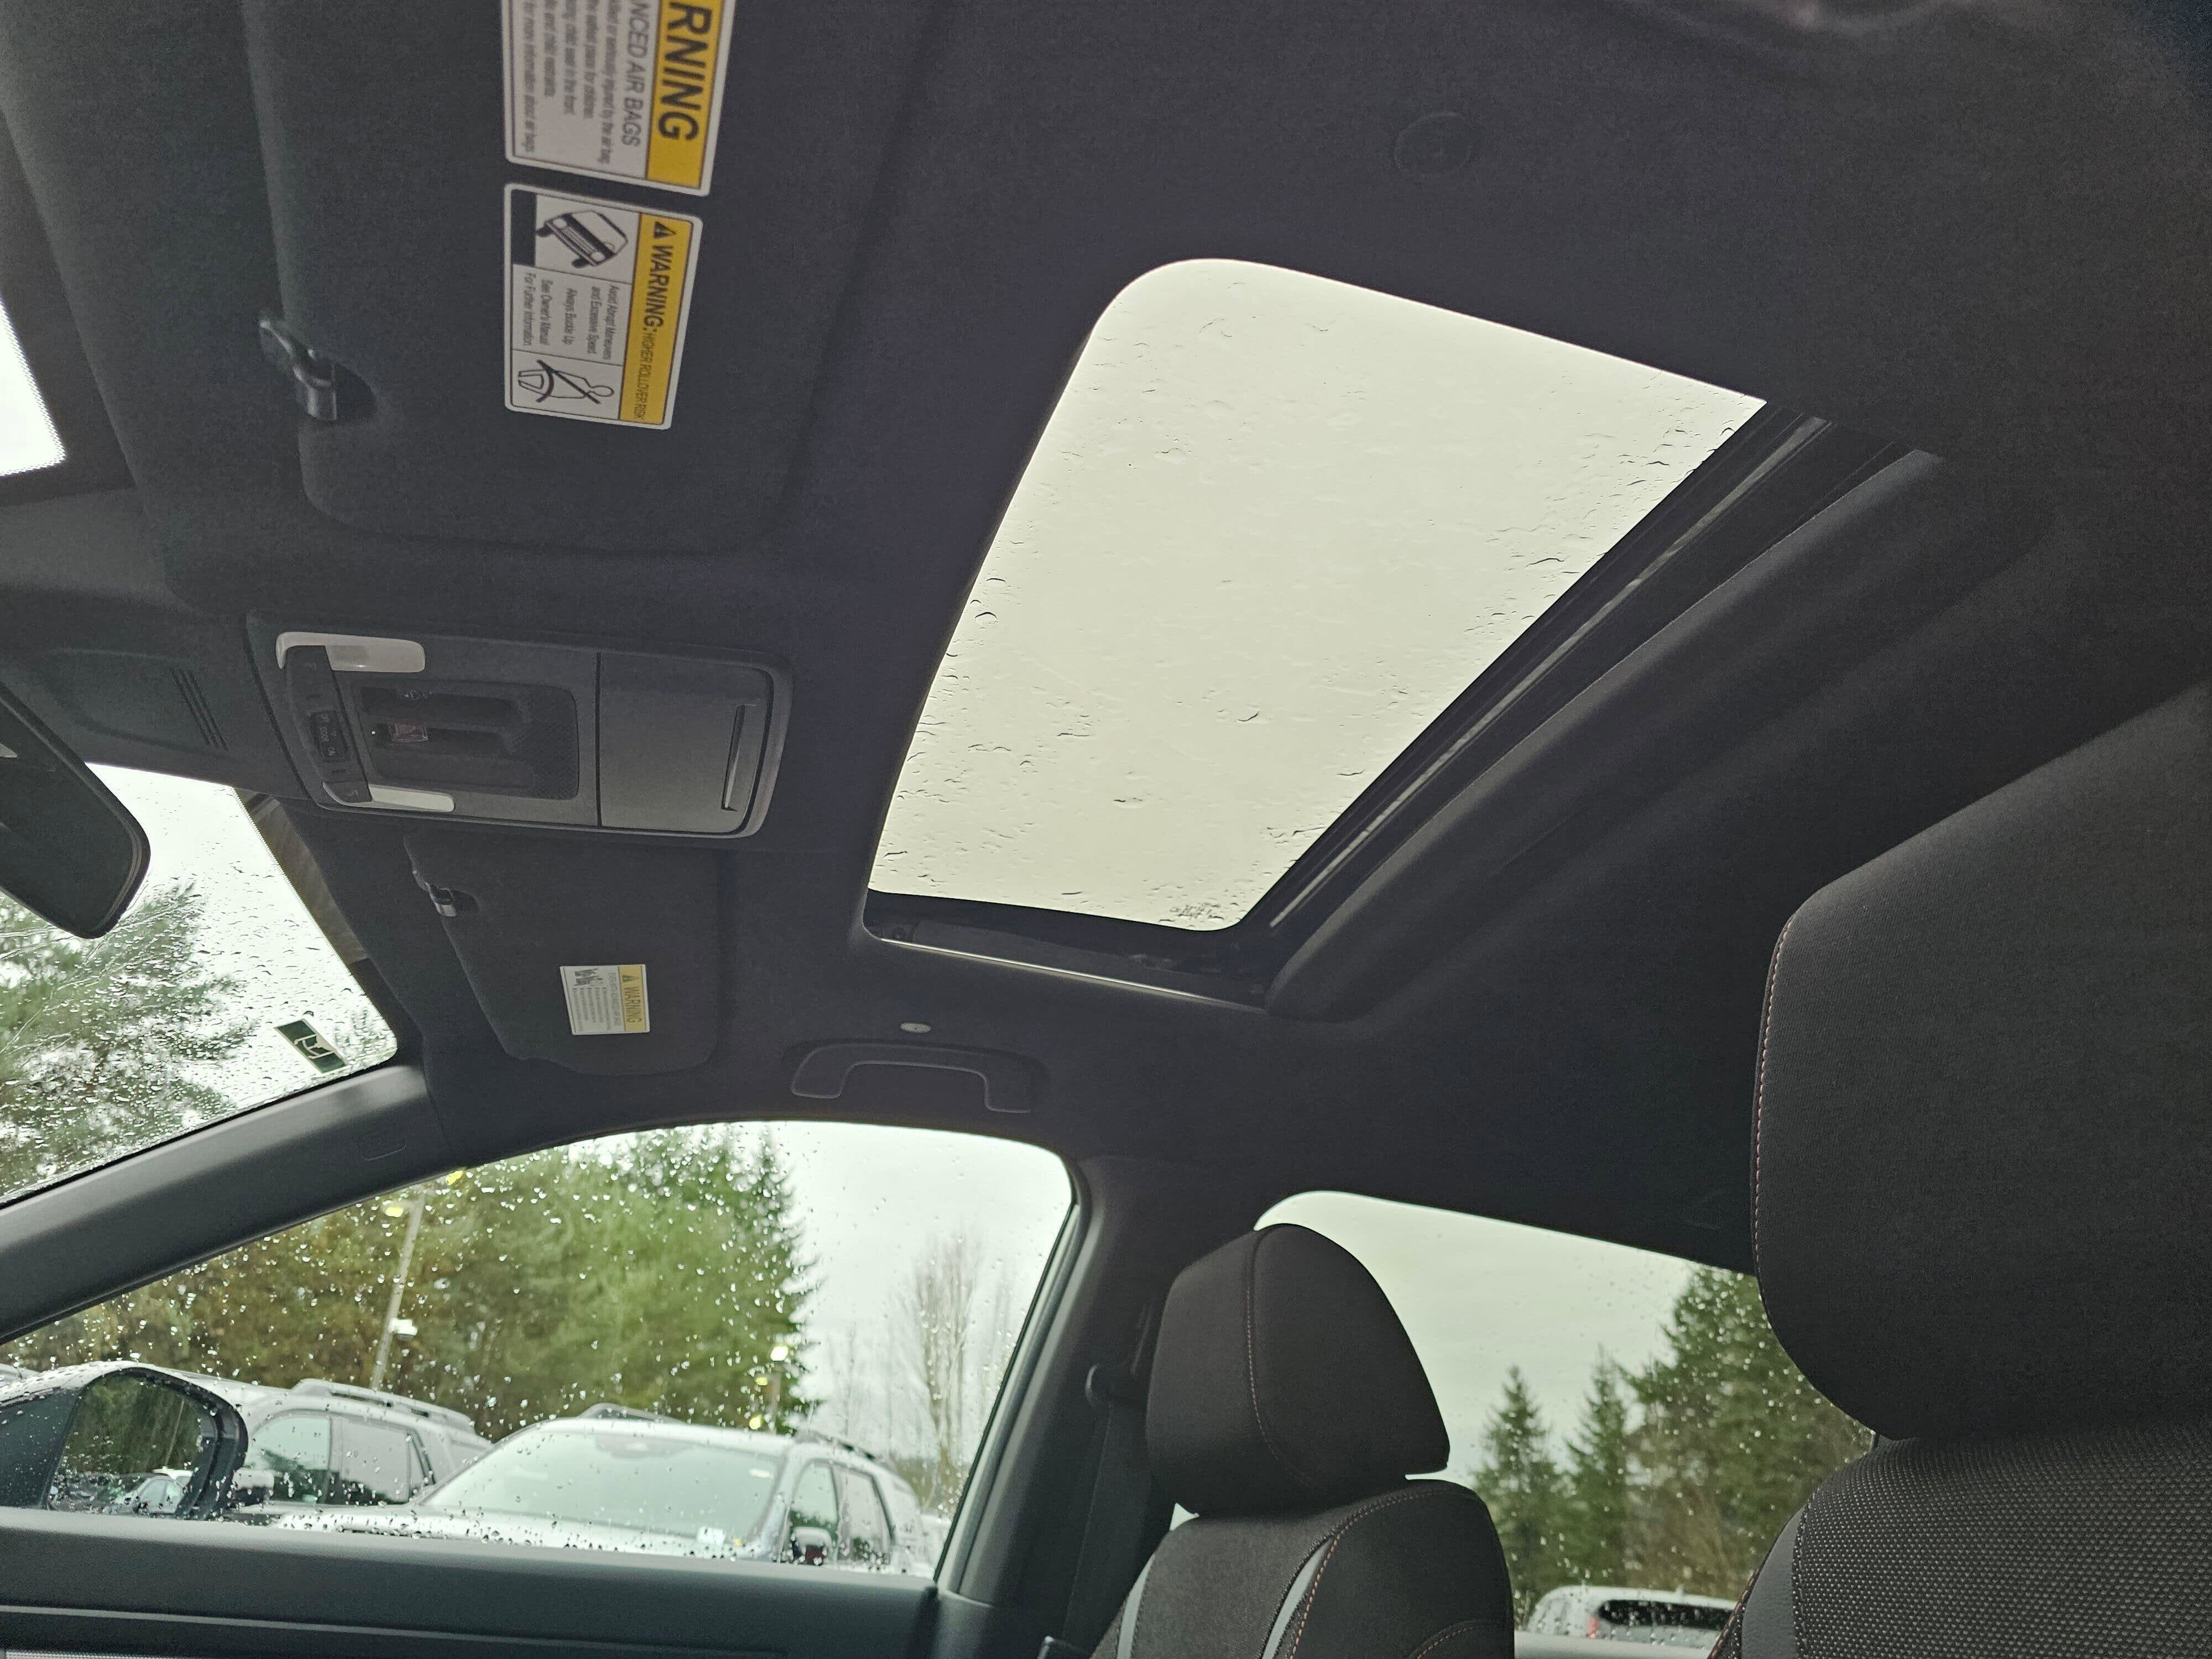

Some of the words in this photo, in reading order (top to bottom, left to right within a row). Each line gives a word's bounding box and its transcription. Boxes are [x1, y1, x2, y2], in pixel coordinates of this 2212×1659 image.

[627, 0, 650, 58] NCED
[625, 61, 646, 93] AIR
[658, 1, 713, 142] RNING
[621, 97, 644, 147] BAGS
[563, 288, 578, 312] Always
[591, 286, 602, 300] and
[607, 285, 619, 304] Avoid
[643, 244, 674, 332] WARNING:
[588, 301, 603, 333] Excessive
[603, 304, 618, 326] Abrupt
[562, 335, 575, 345] Up
[586, 333, 599, 354] Speed
[603, 327, 617, 360] Maneuvers
[641, 333, 656, 362] HIGHER
[635, 365, 652, 404] ROLLOVER
[634, 404, 647, 420] RISK
[327, 747, 336, 756] ON
[624, 987, 643, 1023] WARNING
